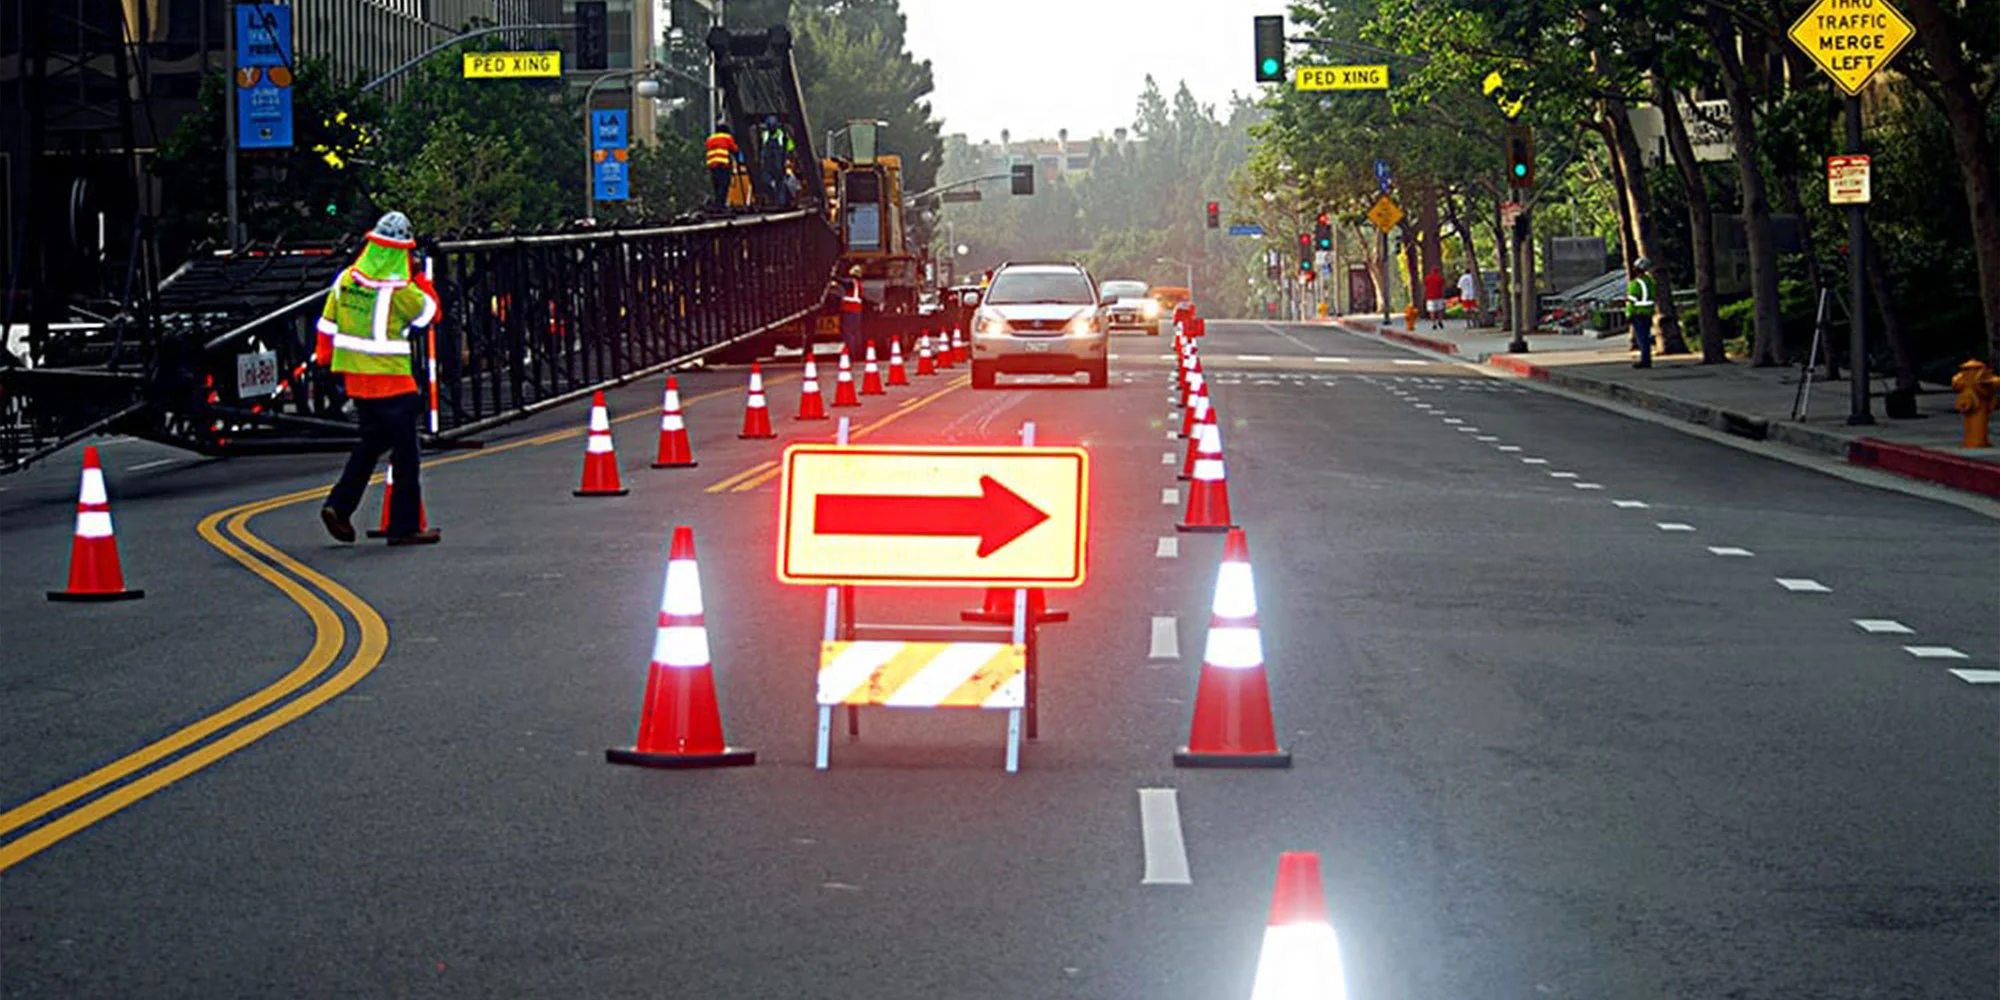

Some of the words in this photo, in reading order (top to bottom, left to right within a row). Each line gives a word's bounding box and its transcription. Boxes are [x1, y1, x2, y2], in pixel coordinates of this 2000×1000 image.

[1831, 0, 1873, 9] THRU
[248, 11, 278, 29] LA
[1817, 14, 1887, 29] TRAFFIC
[1819, 35, 1885, 50] MERGE
[473, 57, 506, 73] PED
[512, 55, 551, 73] XING
[1831, 55, 1875, 70] LEFT
[1303, 70, 1336, 86] PED
[1343, 69, 1380, 84] XING
[599, 113, 620, 126] LA
